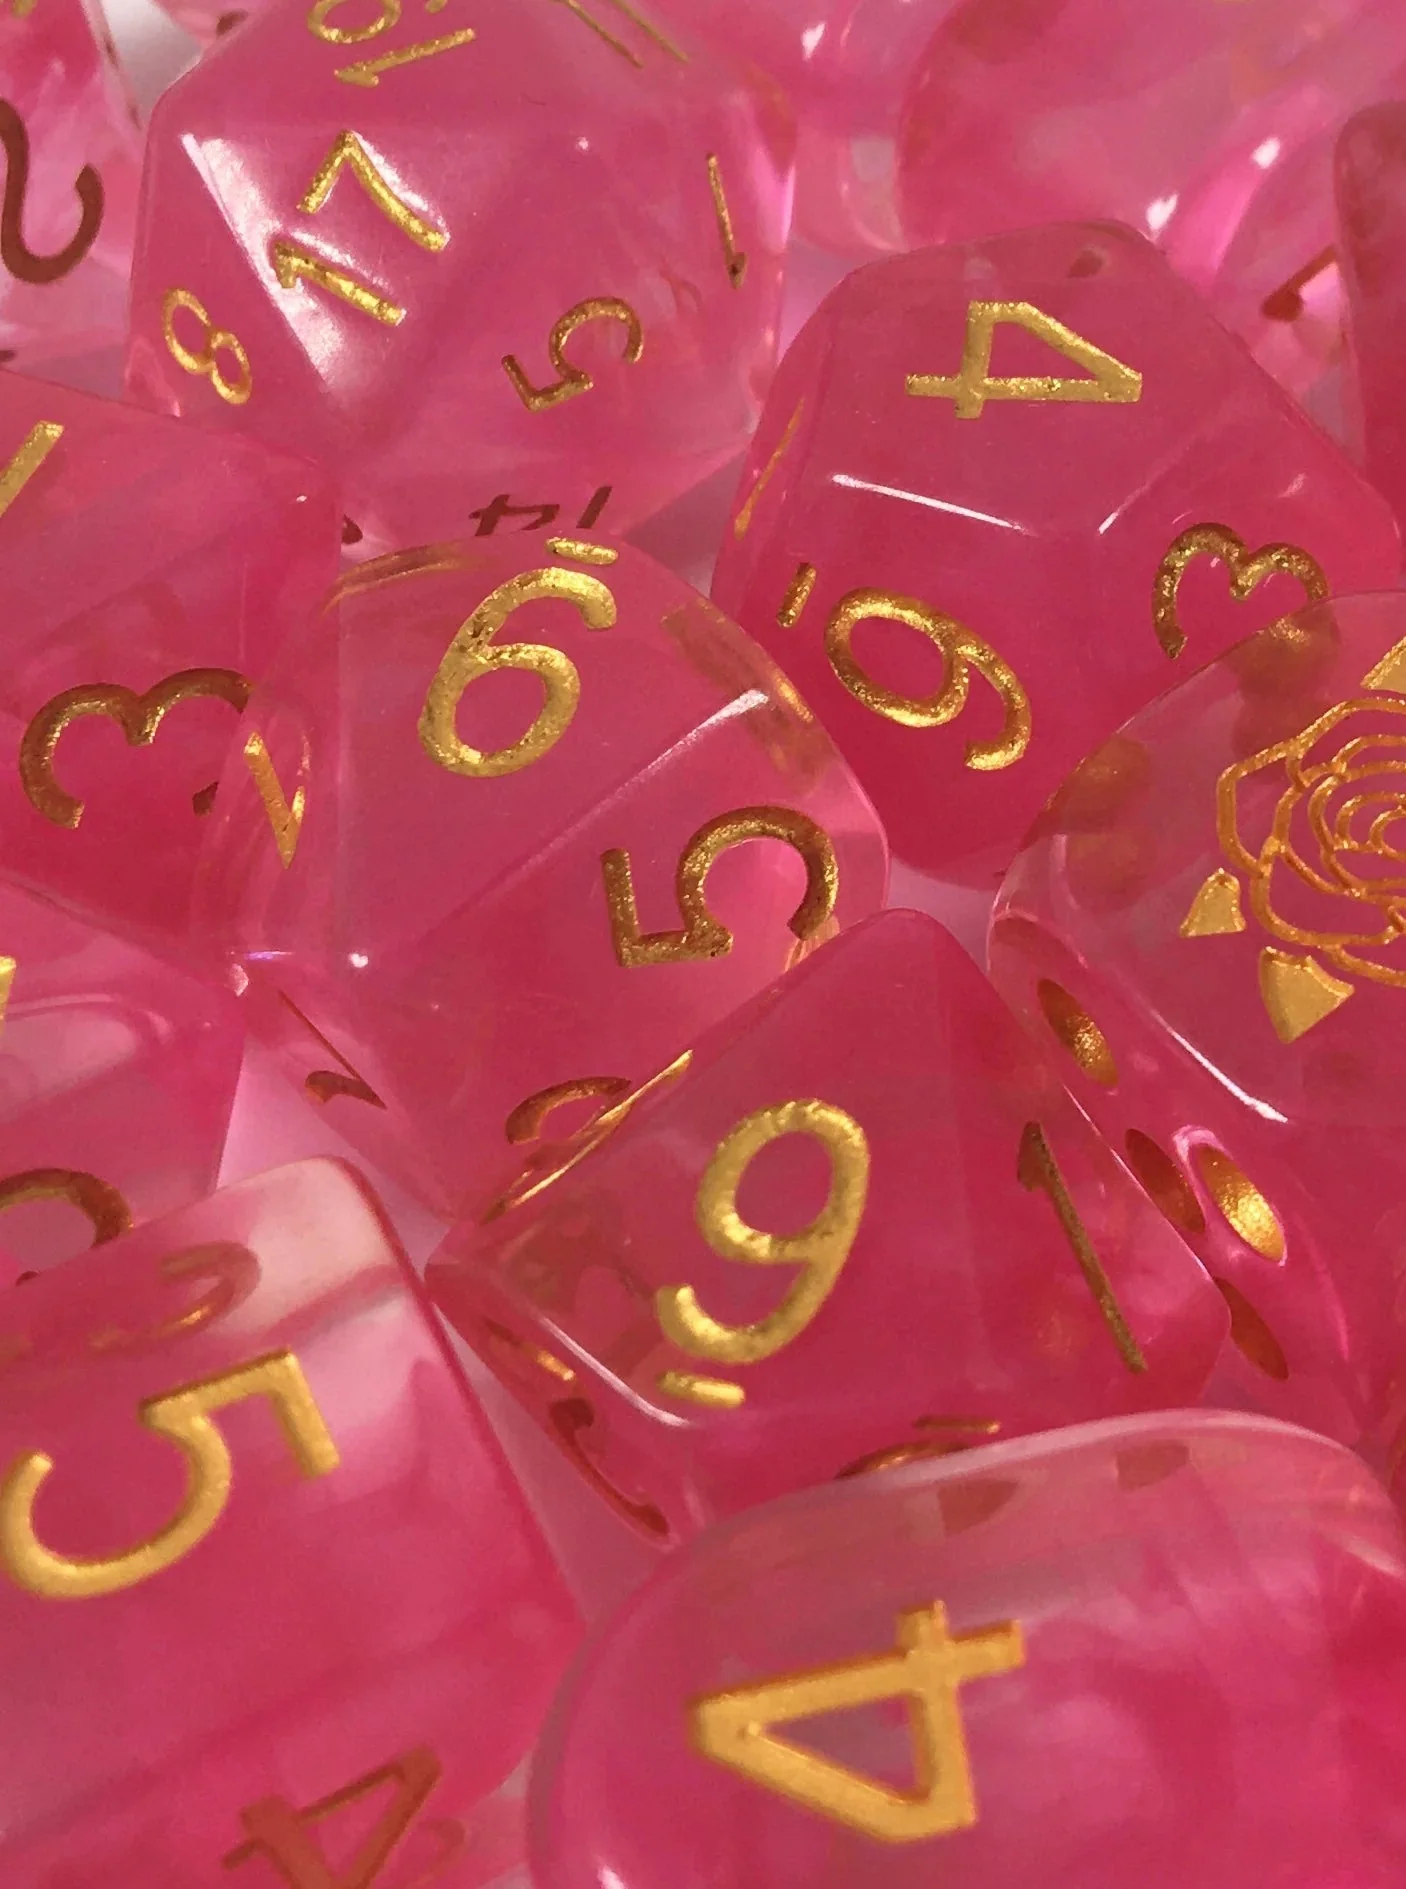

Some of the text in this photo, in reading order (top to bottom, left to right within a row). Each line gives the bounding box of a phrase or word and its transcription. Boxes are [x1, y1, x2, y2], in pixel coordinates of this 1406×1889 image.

[264, 130, 450, 327] 17
[162, 287, 252, 405] 8
[501, 297, 643, 411] 5
[905, 301, 1142, 420] 4
[19, 667, 252, 829] 3
[603, 805, 840, 969] 5
[657, 1099, 871, 1364] 9
[1017, 1120, 1147, 1374] 1
[1, 1350, 341, 1598] 5
[686, 1600, 1025, 1844] 4
